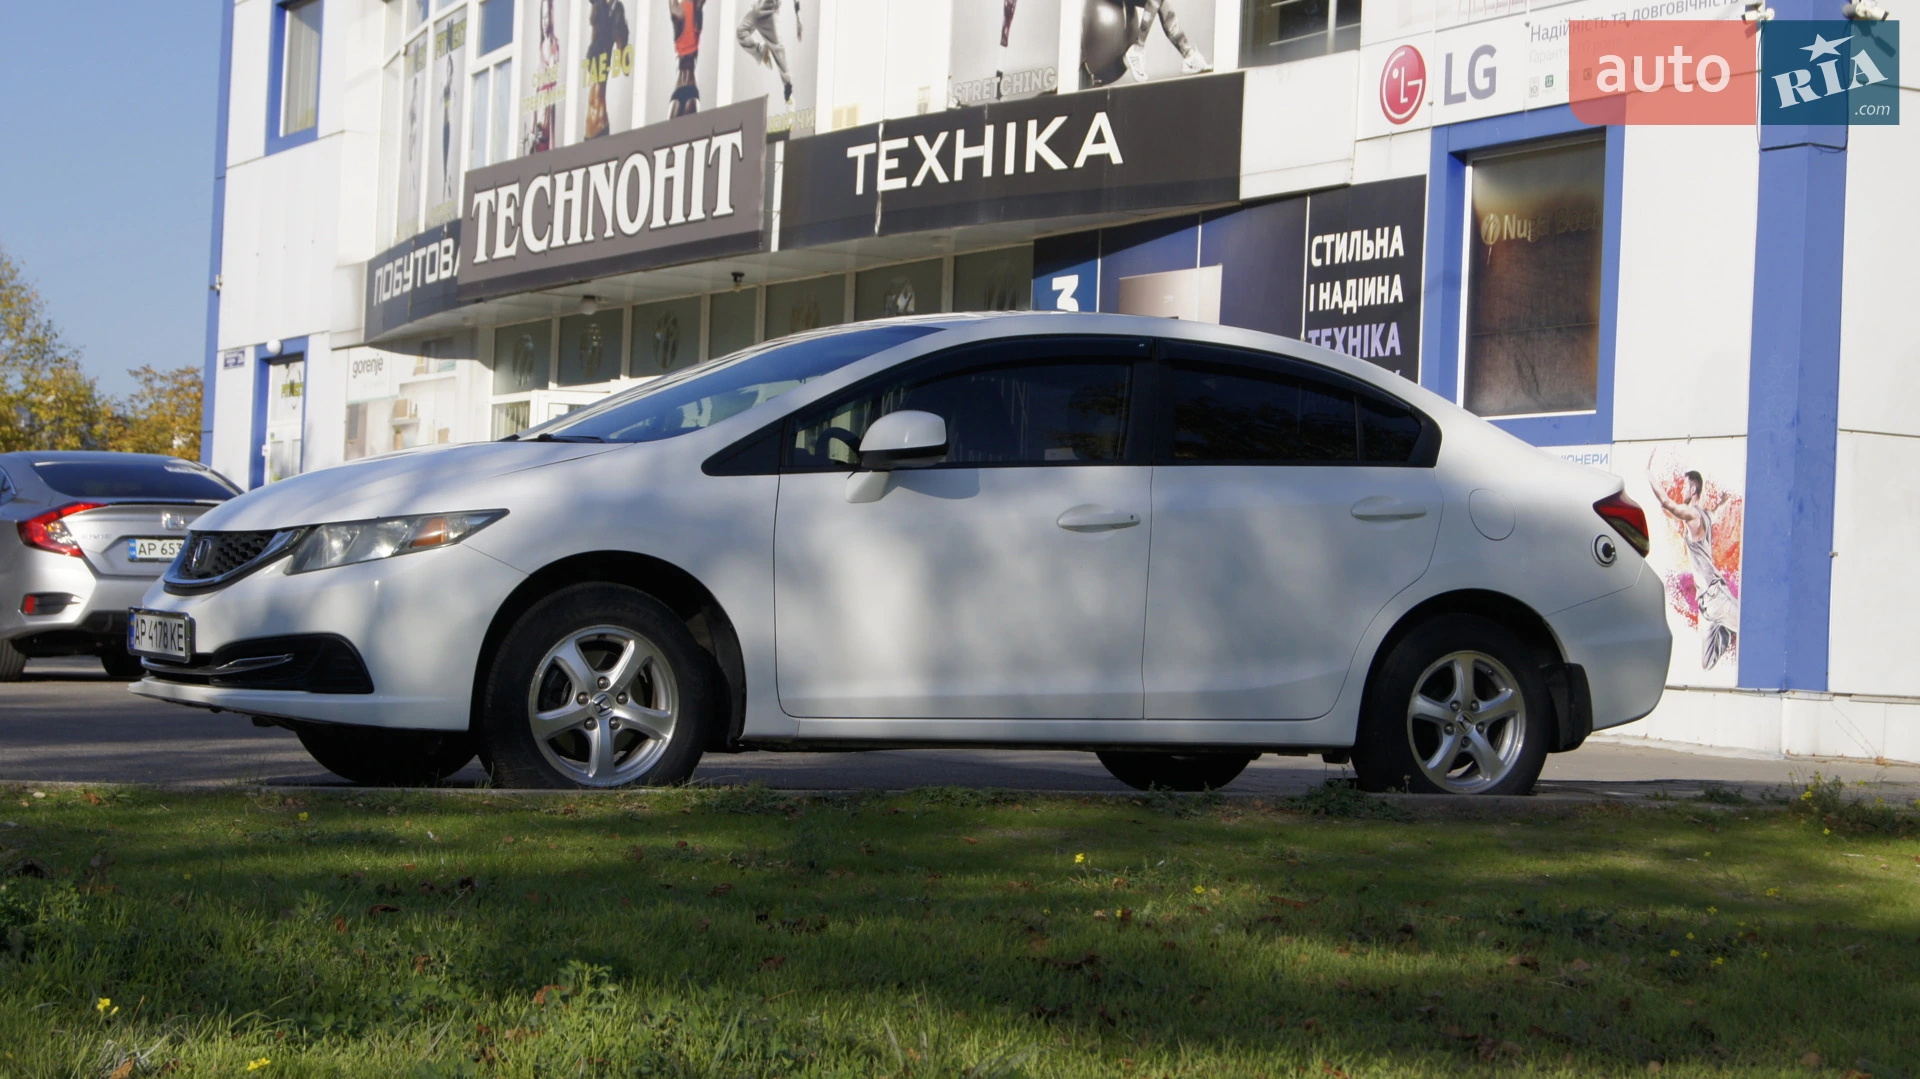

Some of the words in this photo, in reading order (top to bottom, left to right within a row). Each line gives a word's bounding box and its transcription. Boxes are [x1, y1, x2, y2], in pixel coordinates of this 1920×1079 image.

[1611, 12, 1627, 27] та
[582, 44, 634, 88] TAE-BO
[954, 66, 1057, 103] STRETCHING
[1443, 44, 1497, 106] LG
[847, 111, 1123, 195] ТЕХНІКА
[471, 130, 743, 265] TECHNOHIT
[1311, 225, 1404, 267] СТИЛЬНА
[1308, 322, 1402, 359] ТЕХНІКА
[352, 352, 384, 380] gorenje
[161, 541, 182, 556] 653
[148, 621, 170, 648] 4178
[170, 622, 185, 652] KE
